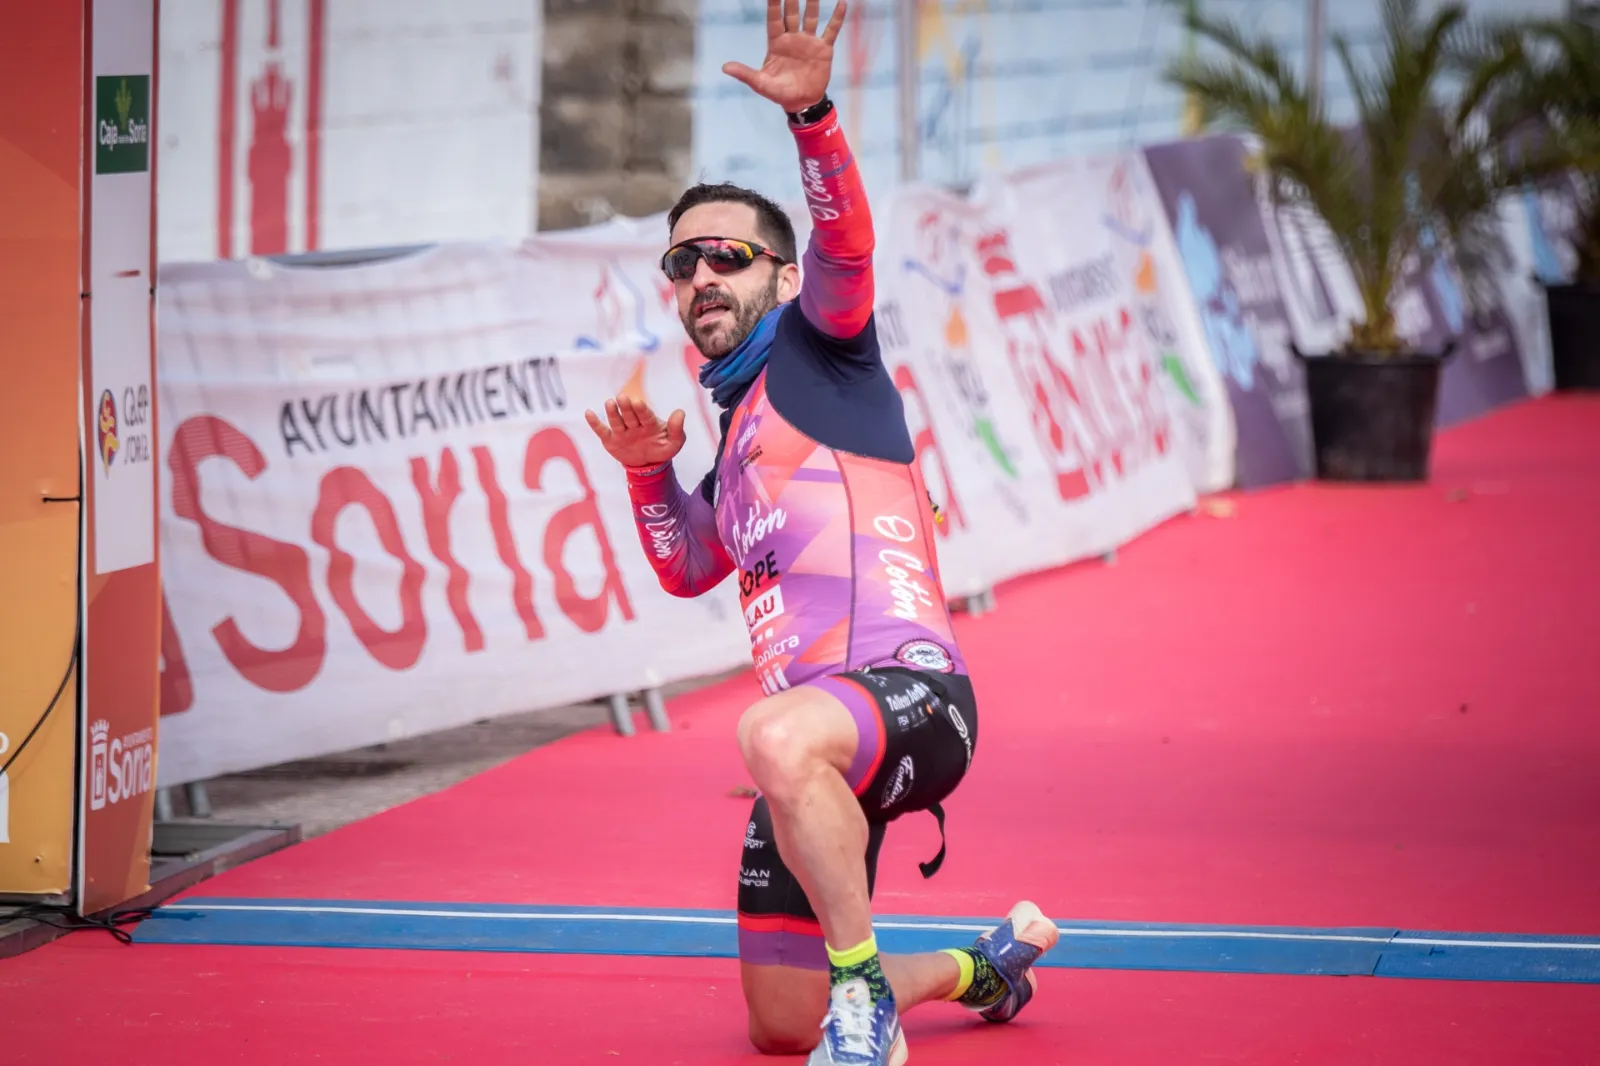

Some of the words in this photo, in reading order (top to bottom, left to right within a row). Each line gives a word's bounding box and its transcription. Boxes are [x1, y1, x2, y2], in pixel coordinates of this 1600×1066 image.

[100, 118, 118, 151] Caja
[128, 117, 147, 144] Soria
[278, 356, 568, 458] AYUNTAMIENTO
[167, 414, 637, 693] Soria
[739, 550, 779, 597] OPE
[746, 595, 775, 628] LAU
[108, 738, 152, 804] Soria
